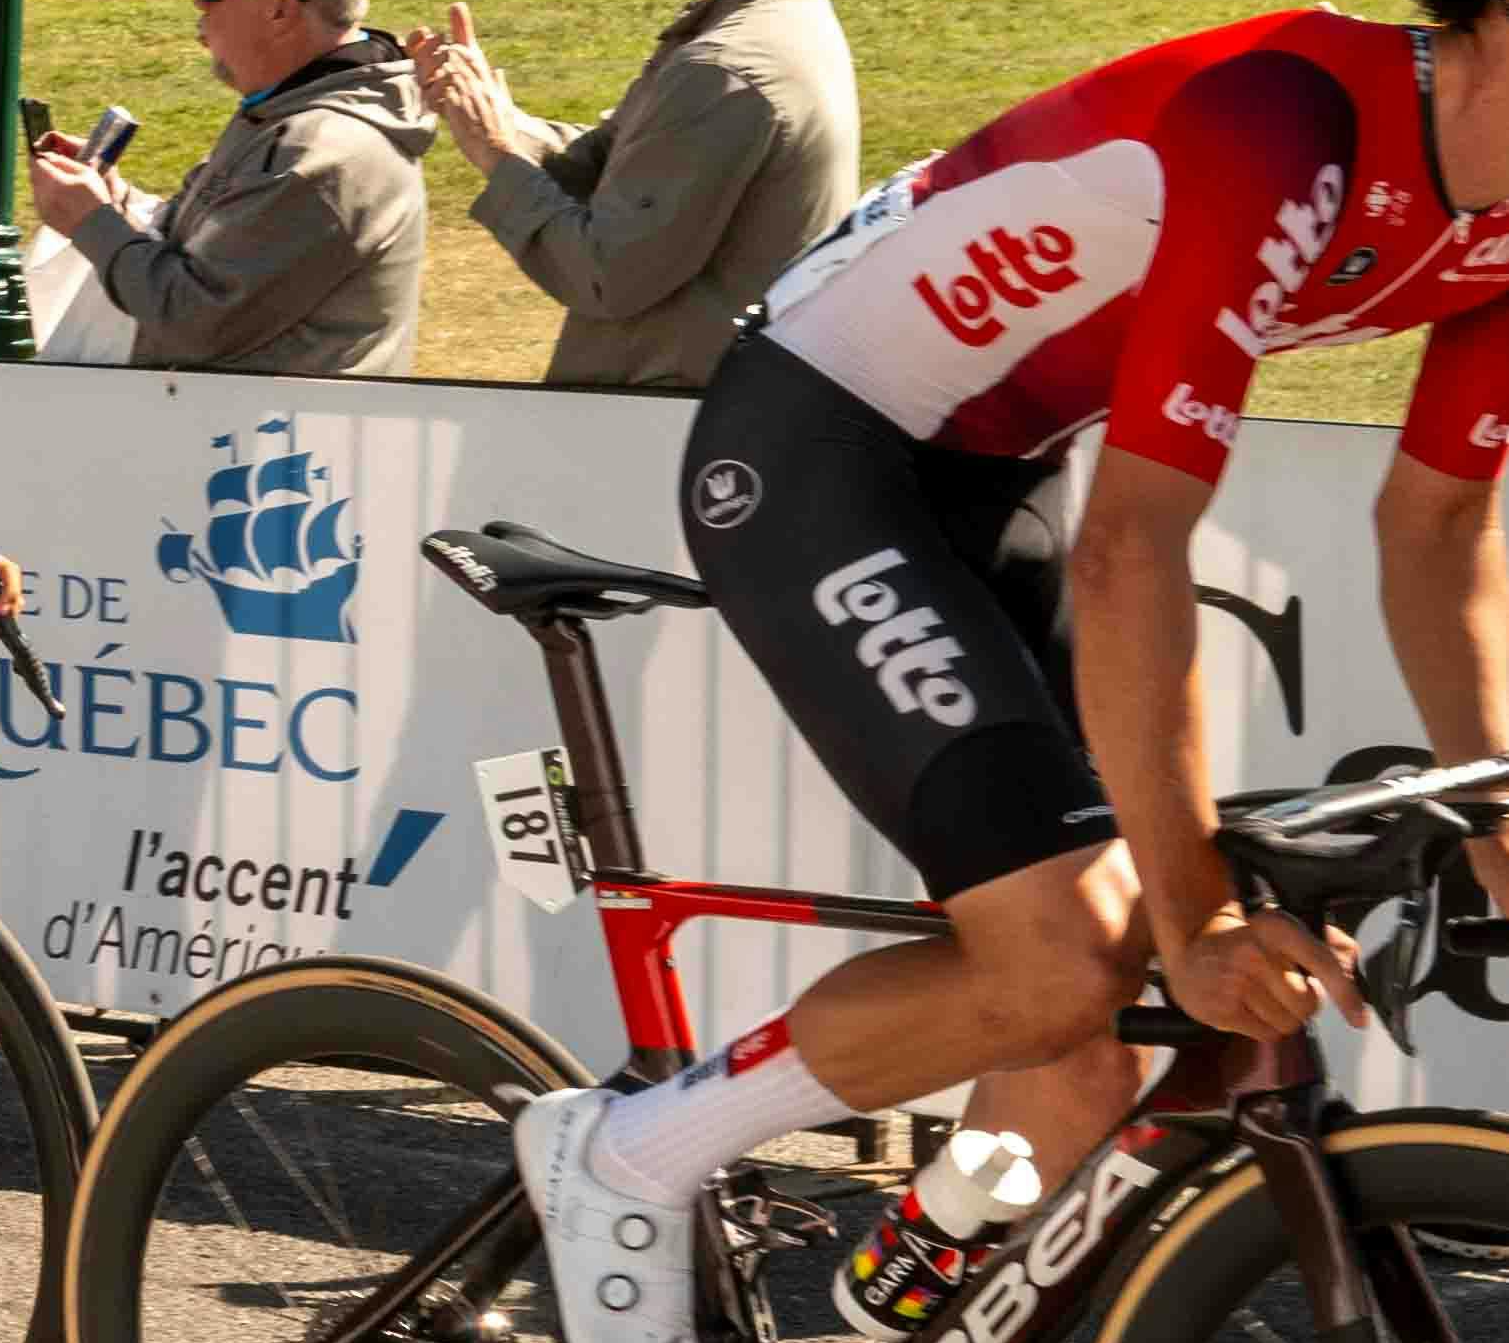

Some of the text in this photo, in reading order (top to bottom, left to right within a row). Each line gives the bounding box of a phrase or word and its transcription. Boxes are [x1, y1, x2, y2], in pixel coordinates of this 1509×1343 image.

[911, 216, 1086, 348] lotto
[1215, 163, 1344, 359] lotto
[59, 574, 129, 623] DE
[813, 546, 978, 730] lotto
[124, 828, 358, 921] l'accent
[494, 786, 561, 866] 187
